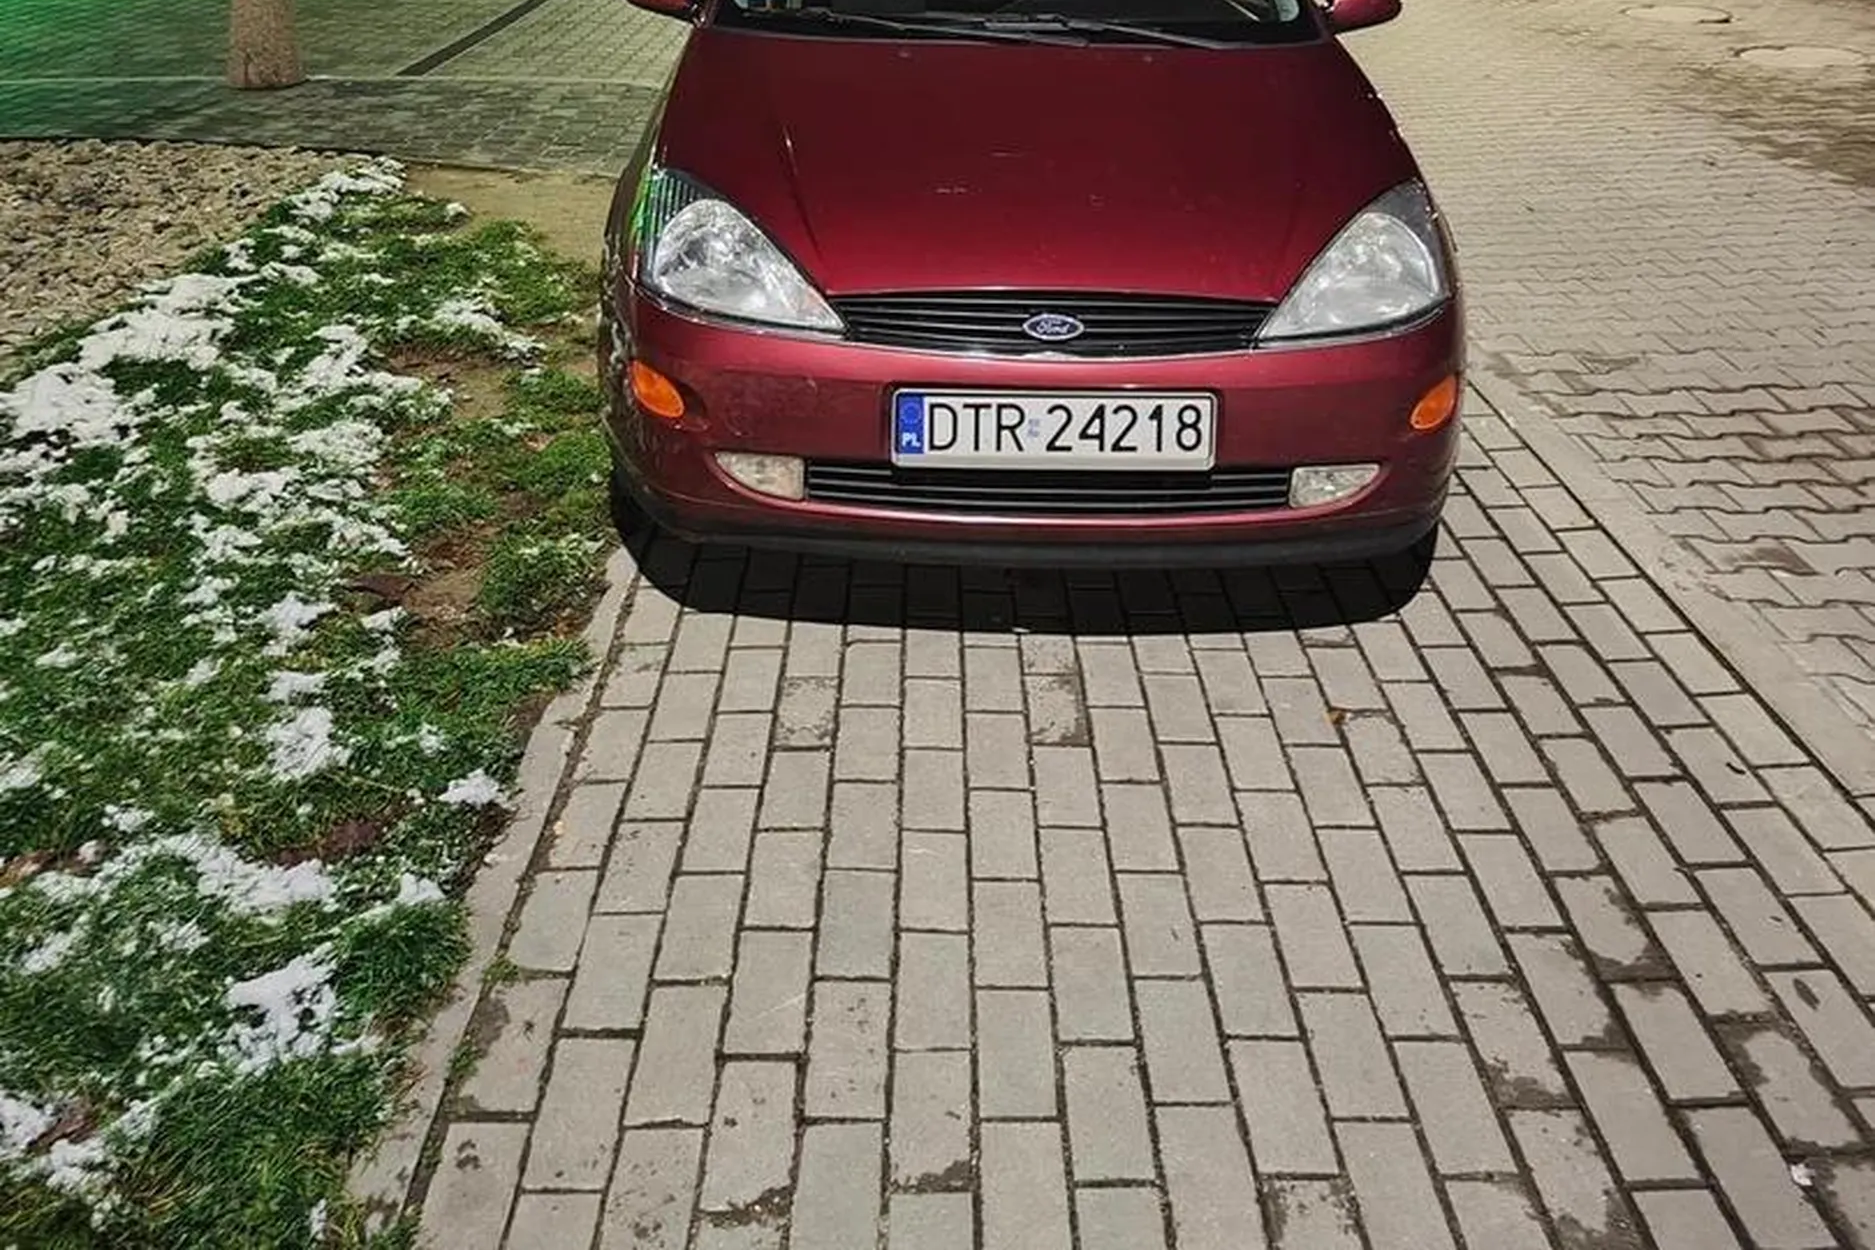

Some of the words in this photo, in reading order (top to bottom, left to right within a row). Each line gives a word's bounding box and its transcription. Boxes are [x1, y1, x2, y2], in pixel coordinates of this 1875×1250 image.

[902, 432, 921, 447] PL
[927, 403, 1025, 452] DTR
[1046, 404, 1203, 452] 24218
